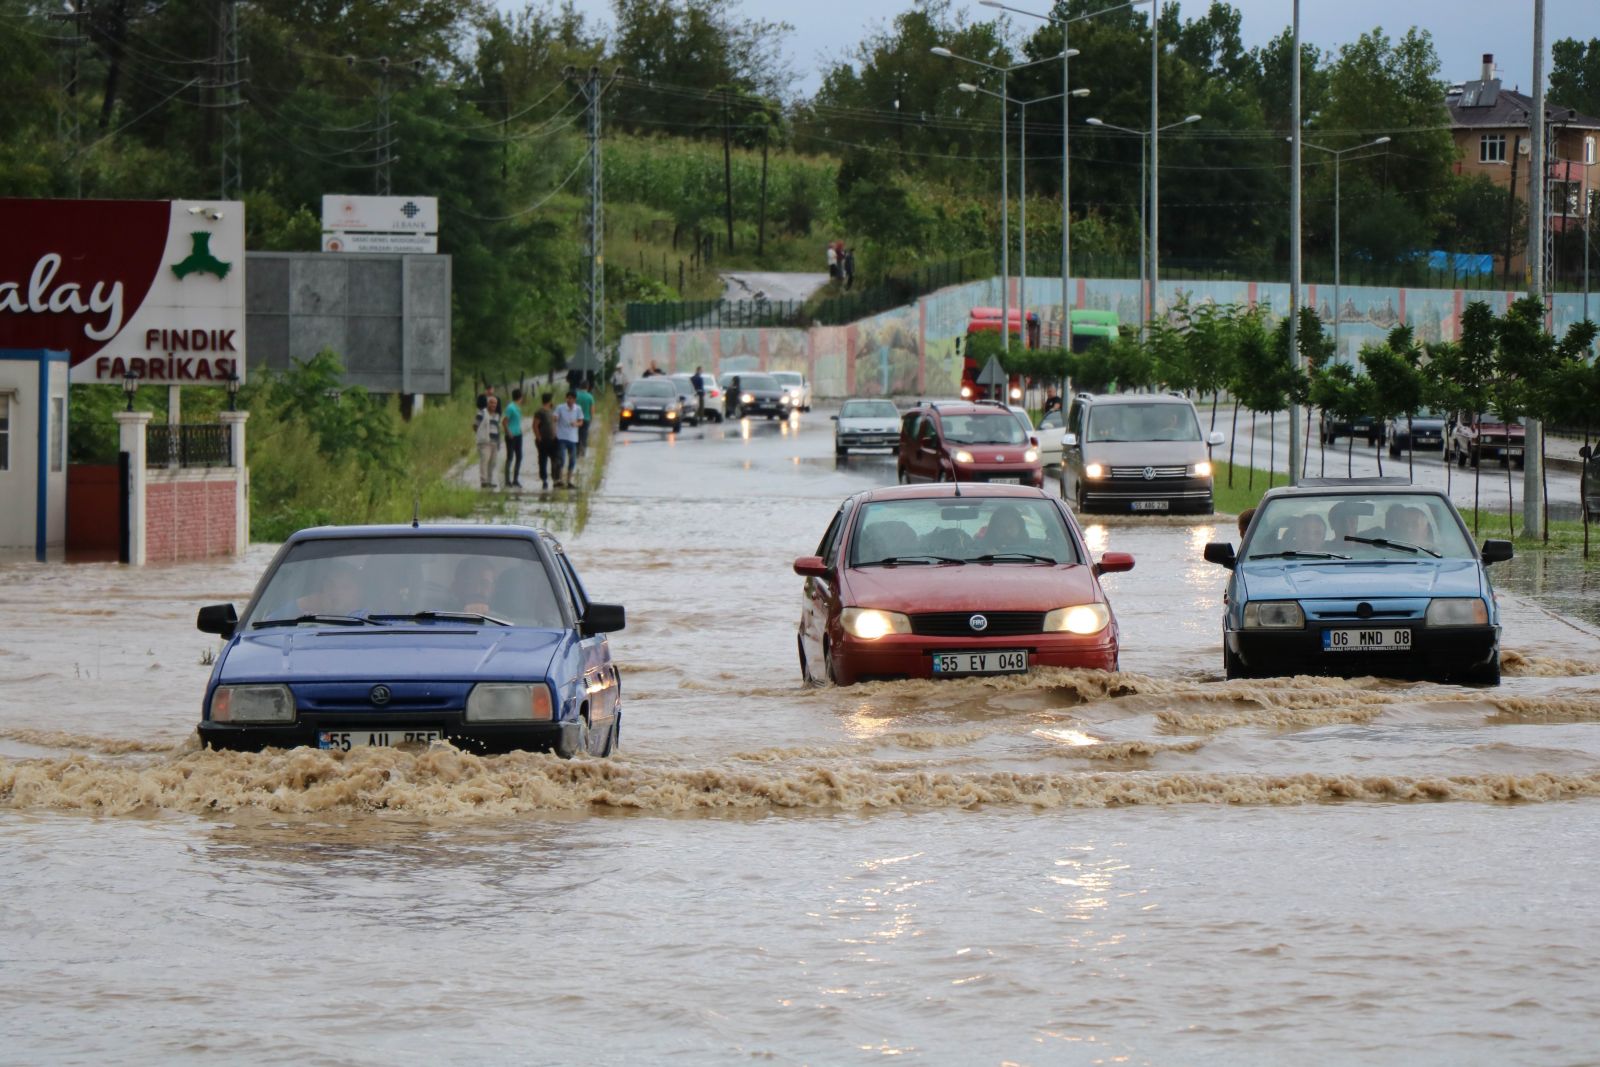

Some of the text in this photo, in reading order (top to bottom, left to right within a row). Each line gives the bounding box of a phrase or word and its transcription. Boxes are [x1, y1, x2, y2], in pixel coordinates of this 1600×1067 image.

[145, 329, 236, 351] FINDIK
[95, 353, 238, 380] FABRİKASI
[1333, 631, 1348, 646] 06
[1360, 631, 1383, 645] MND
[1394, 630, 1410, 644] 08
[941, 656, 958, 671] 55
[970, 655, 986, 670] EV
[999, 653, 1024, 669] 048
[330, 733, 351, 752] 55
